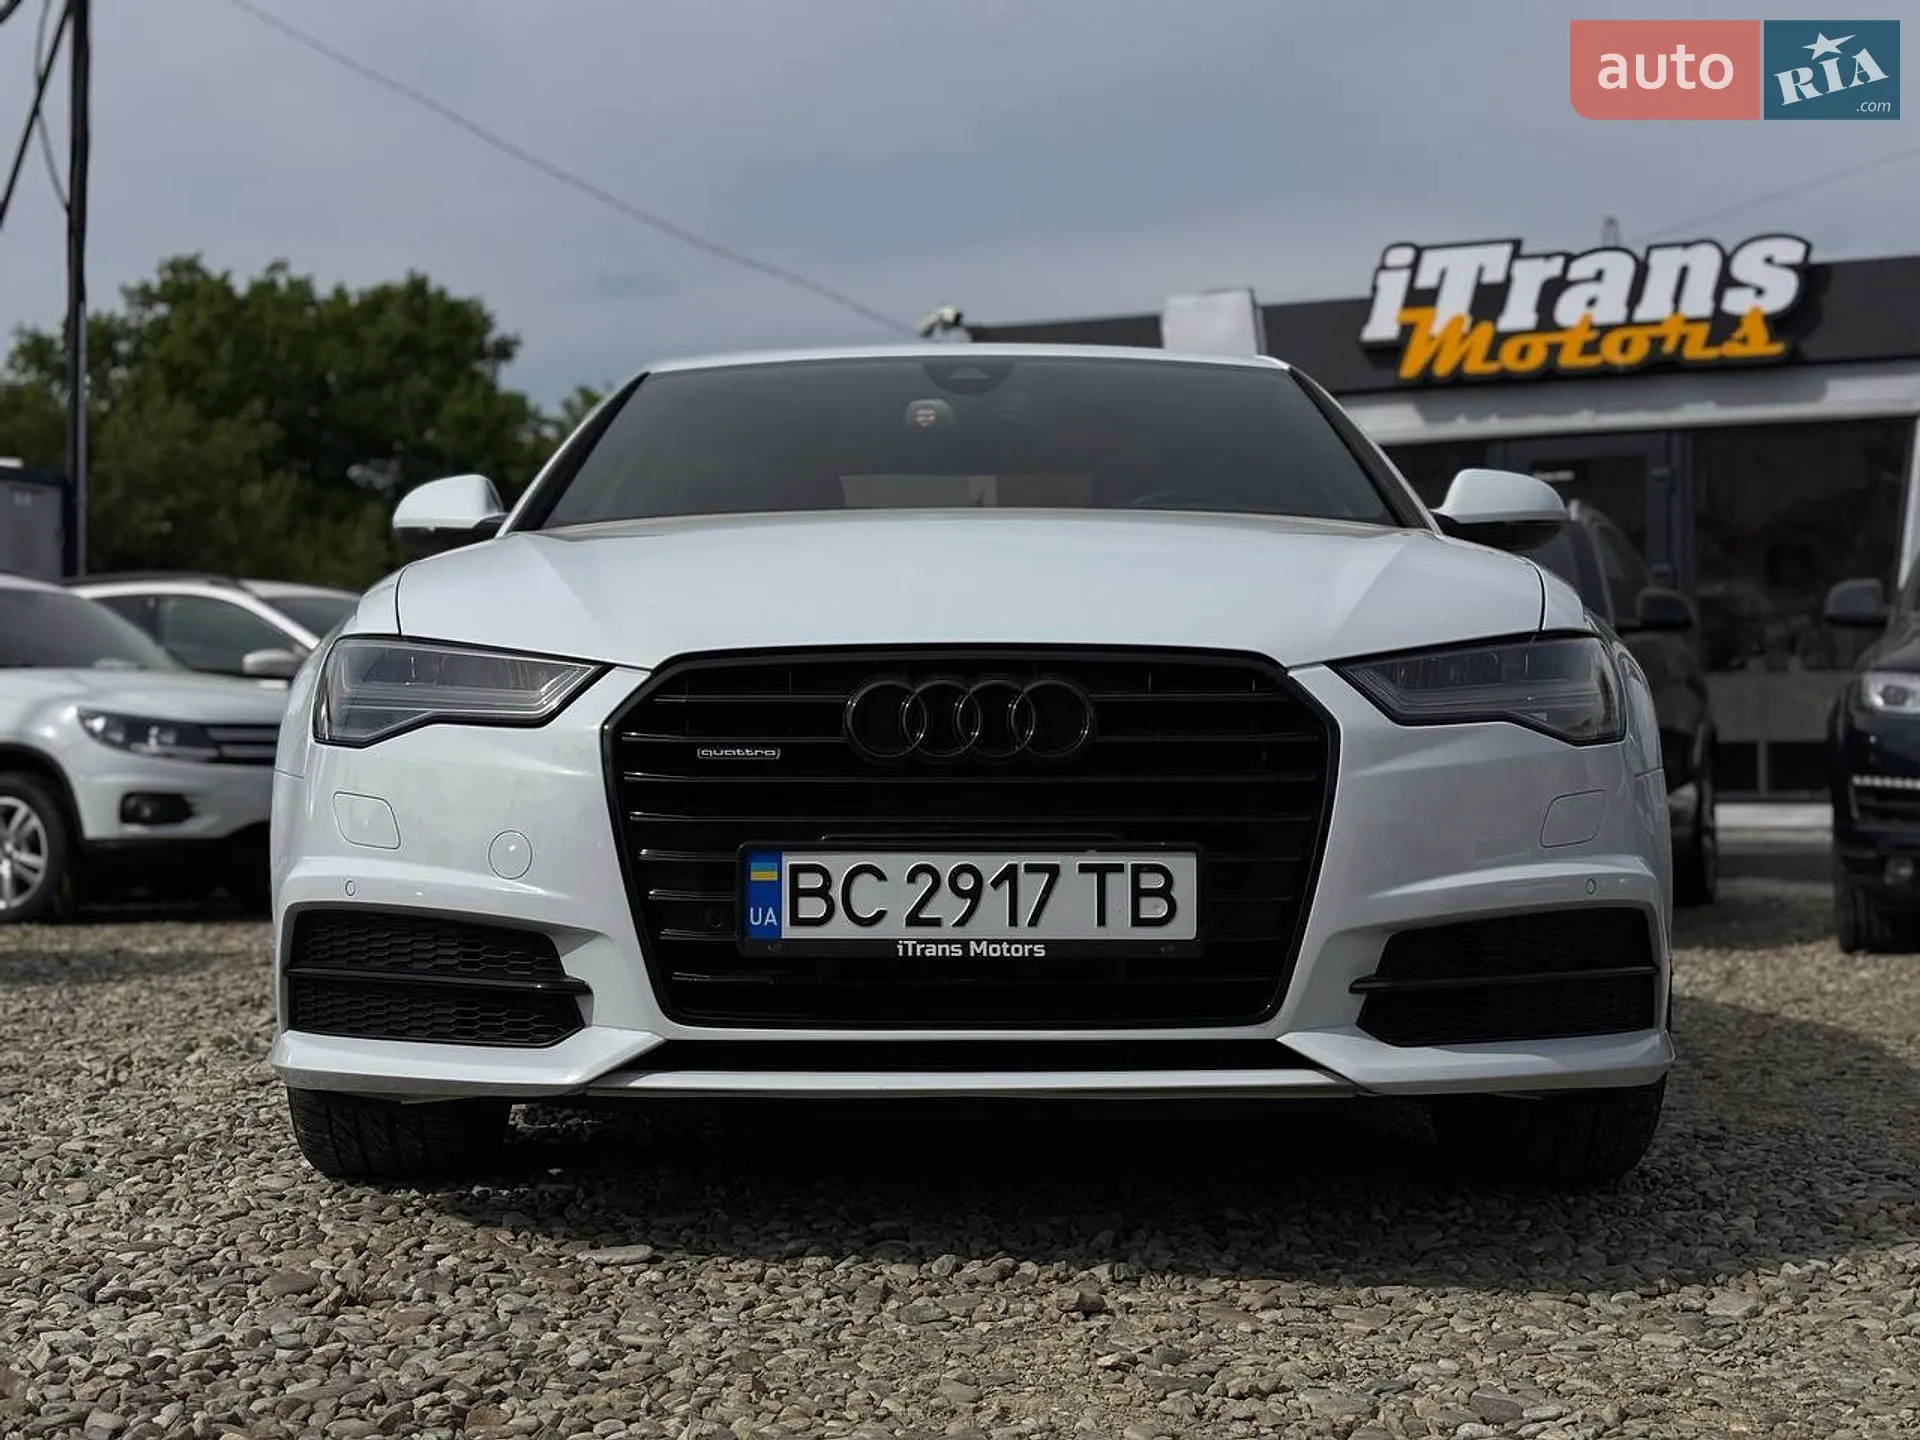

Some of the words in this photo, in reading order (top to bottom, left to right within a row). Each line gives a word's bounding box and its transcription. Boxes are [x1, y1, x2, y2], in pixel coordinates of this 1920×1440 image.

[1359, 235, 1808, 343] iTrans
[1396, 304, 1786, 380] Motors
[700, 748, 777, 757] quattro
[788, 862, 888, 928] BC
[904, 862, 1061, 928] 2917
[1077, 862, 1178, 928] TB
[749, 907, 778, 926] UA
[897, 940, 963, 958] iTrans
[969, 940, 1046, 958] Motors
